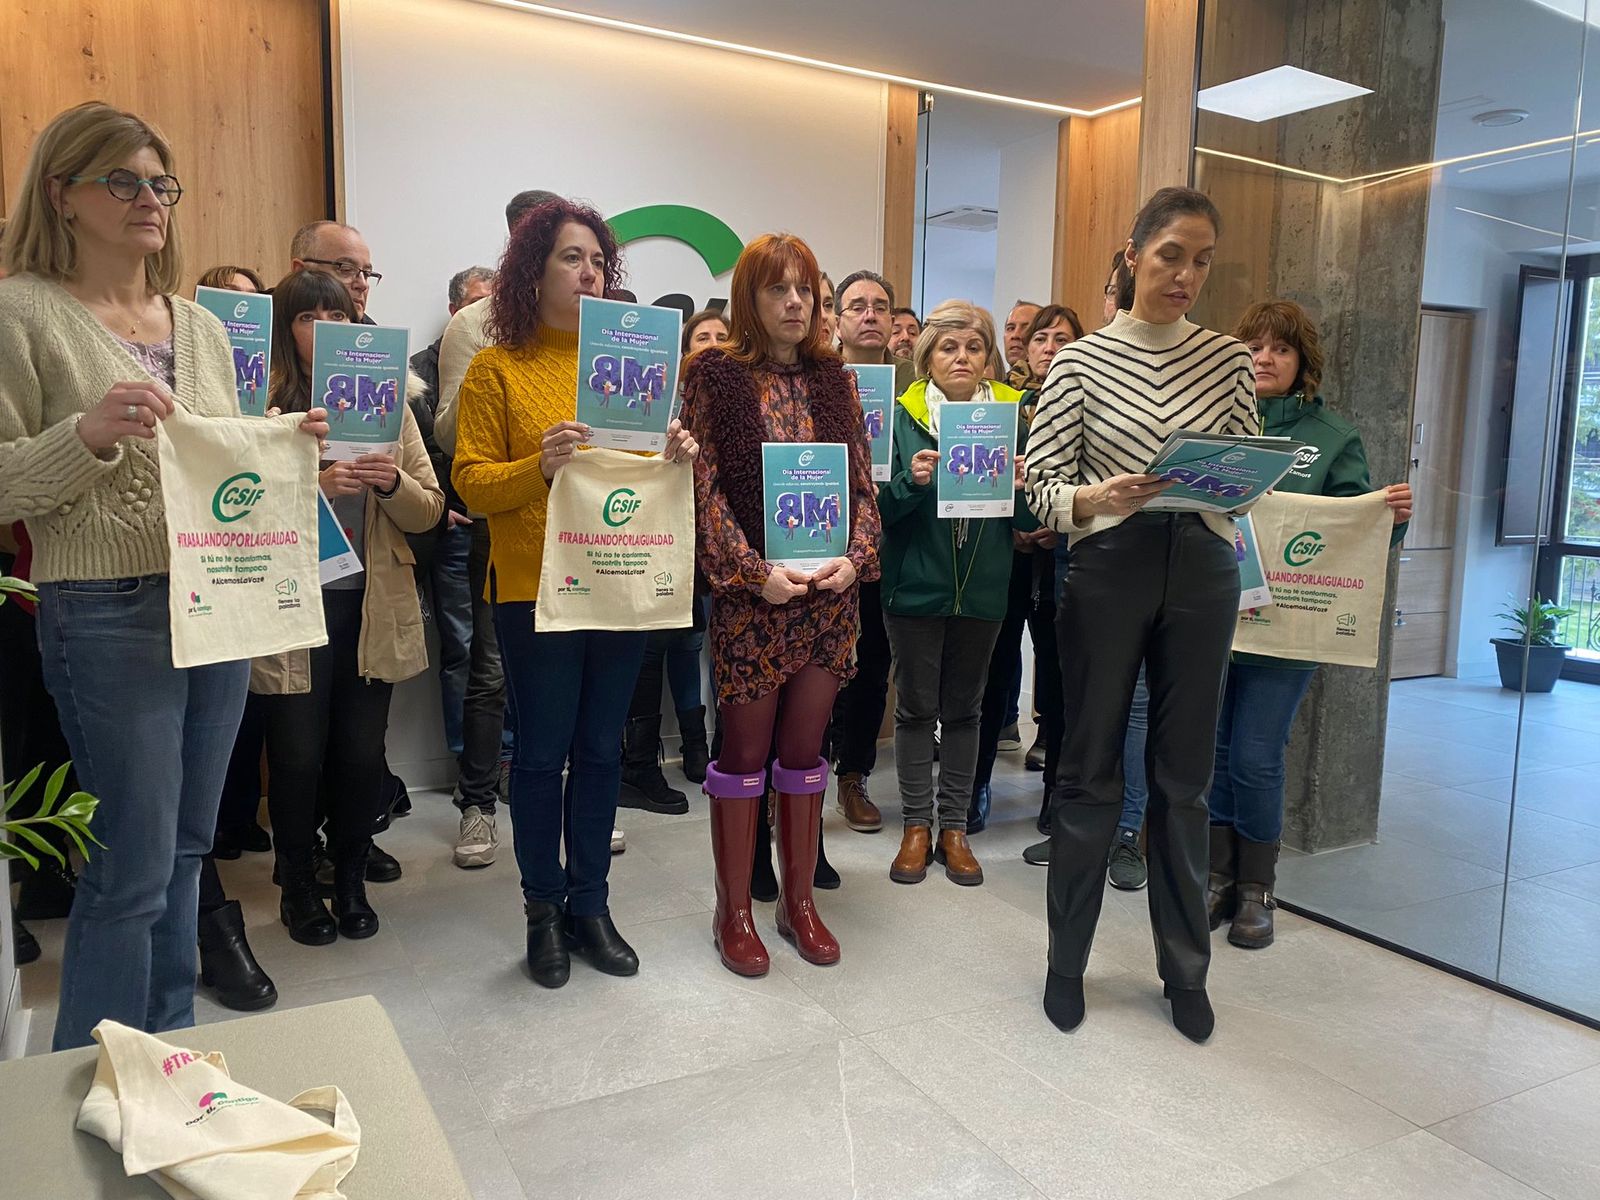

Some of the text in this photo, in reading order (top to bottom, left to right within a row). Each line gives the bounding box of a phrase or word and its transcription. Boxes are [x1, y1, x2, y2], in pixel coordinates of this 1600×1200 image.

[601, 328, 659, 341] Día Internacional
[629, 338, 649, 346] Mujer
[348, 350, 391, 359] Internacional
[588, 354, 668, 402] 8M
[323, 373, 397, 414] 8M
[946, 443, 1008, 476] 8M
[774, 491, 840, 529] 8M
[225, 555, 232, 563] te
[235, 564, 268, 574] tampoco
[1301, 597, 1332, 605] tampoco
[162, 1052, 197, 1077] #TR
